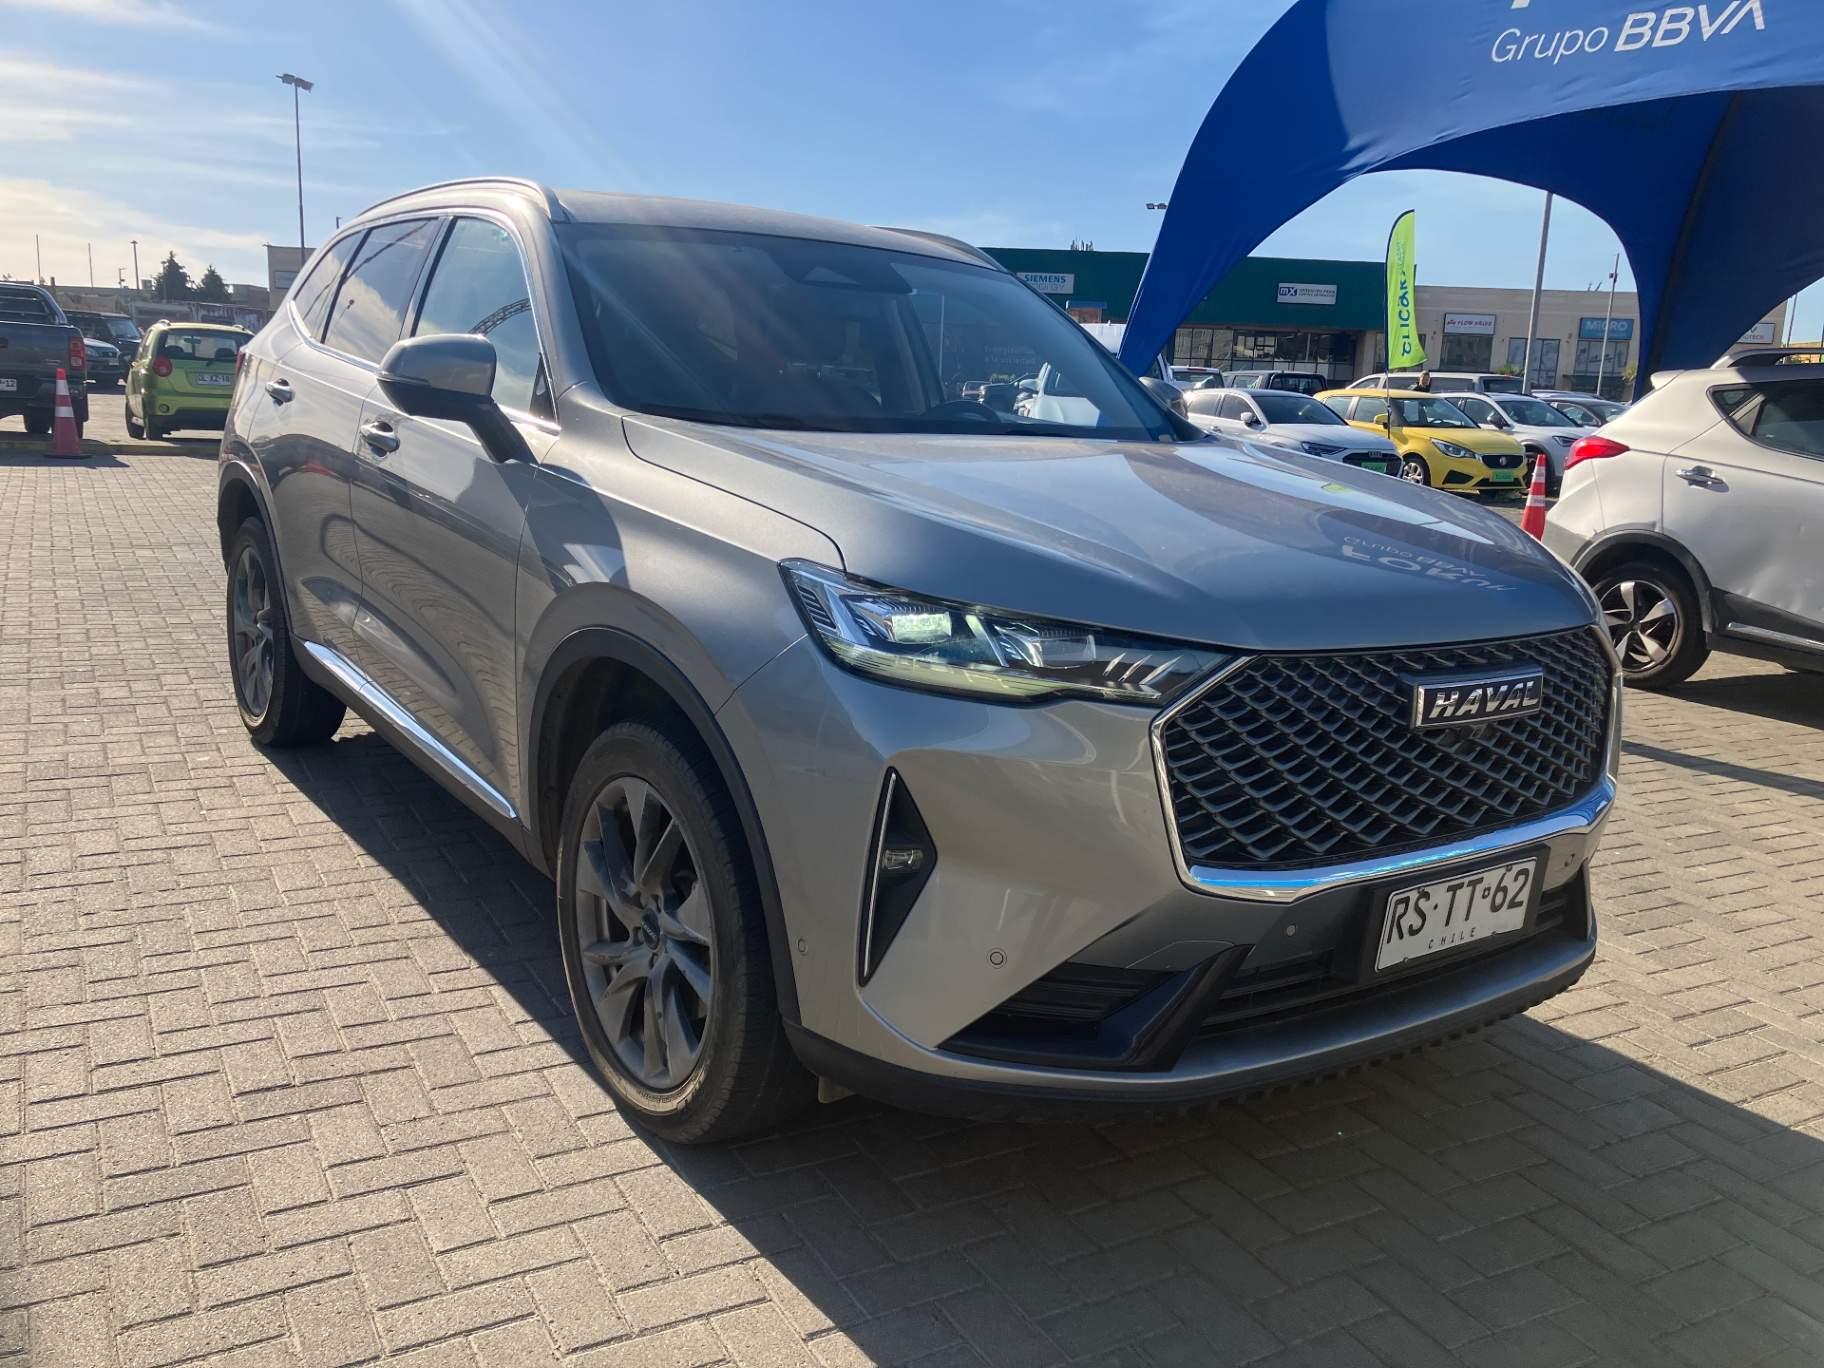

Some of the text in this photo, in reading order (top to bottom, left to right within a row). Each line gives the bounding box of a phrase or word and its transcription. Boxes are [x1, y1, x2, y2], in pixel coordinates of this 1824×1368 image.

[1491, 0, 1766, 64] Grupo BBVA
[1024, 274, 1066, 284] SIEMENS
[1429, 681, 1538, 718] HAVAL
[1428, 926, 1476, 949] CHILE
